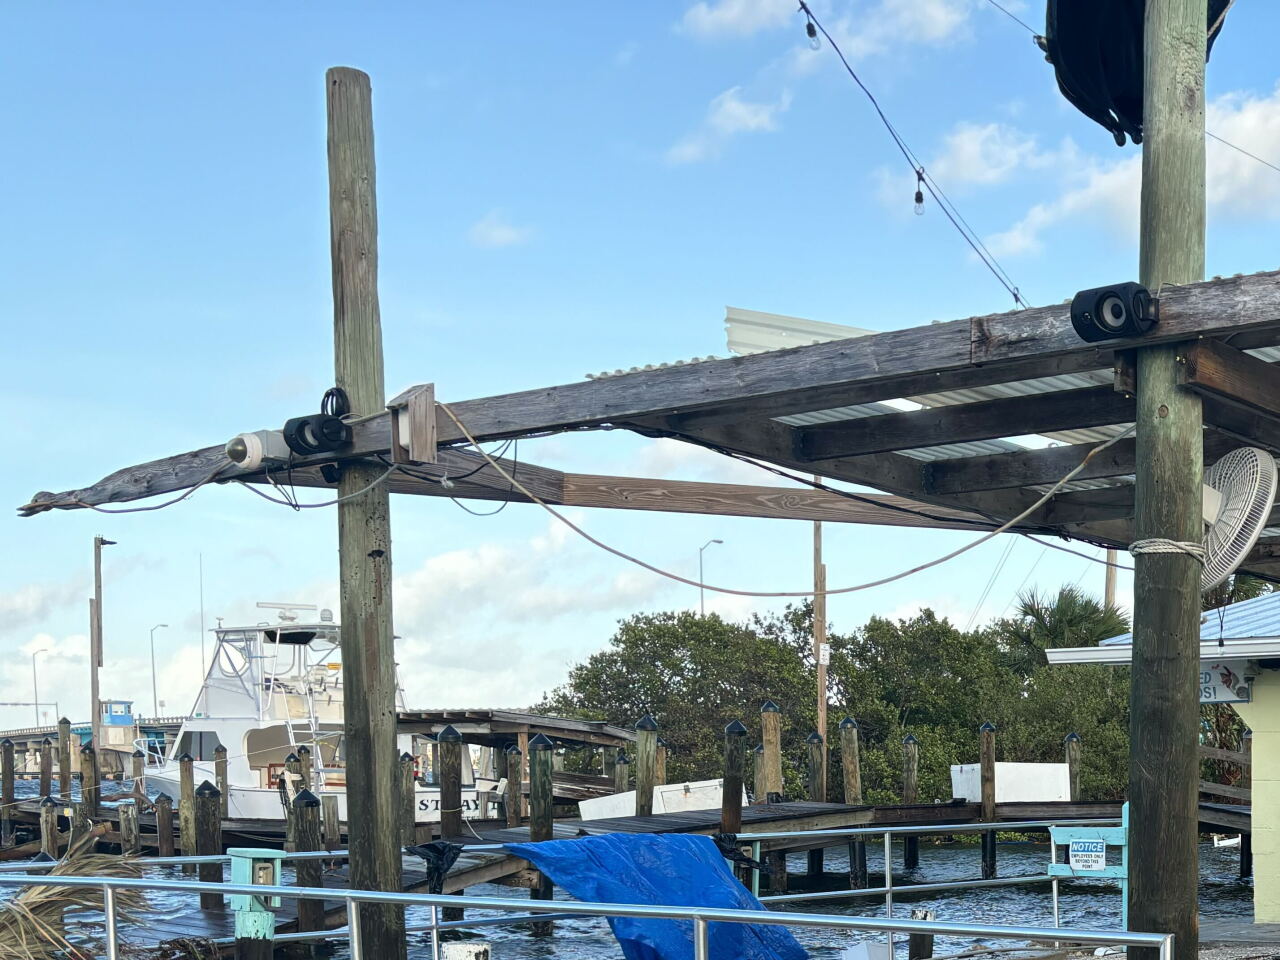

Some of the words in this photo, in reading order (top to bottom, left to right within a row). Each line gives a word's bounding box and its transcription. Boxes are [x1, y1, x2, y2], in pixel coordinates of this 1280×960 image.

[1200, 671, 1212, 685] ED
[418, 799, 479, 811] STAY
[1072, 842, 1104, 852] NOTICE
